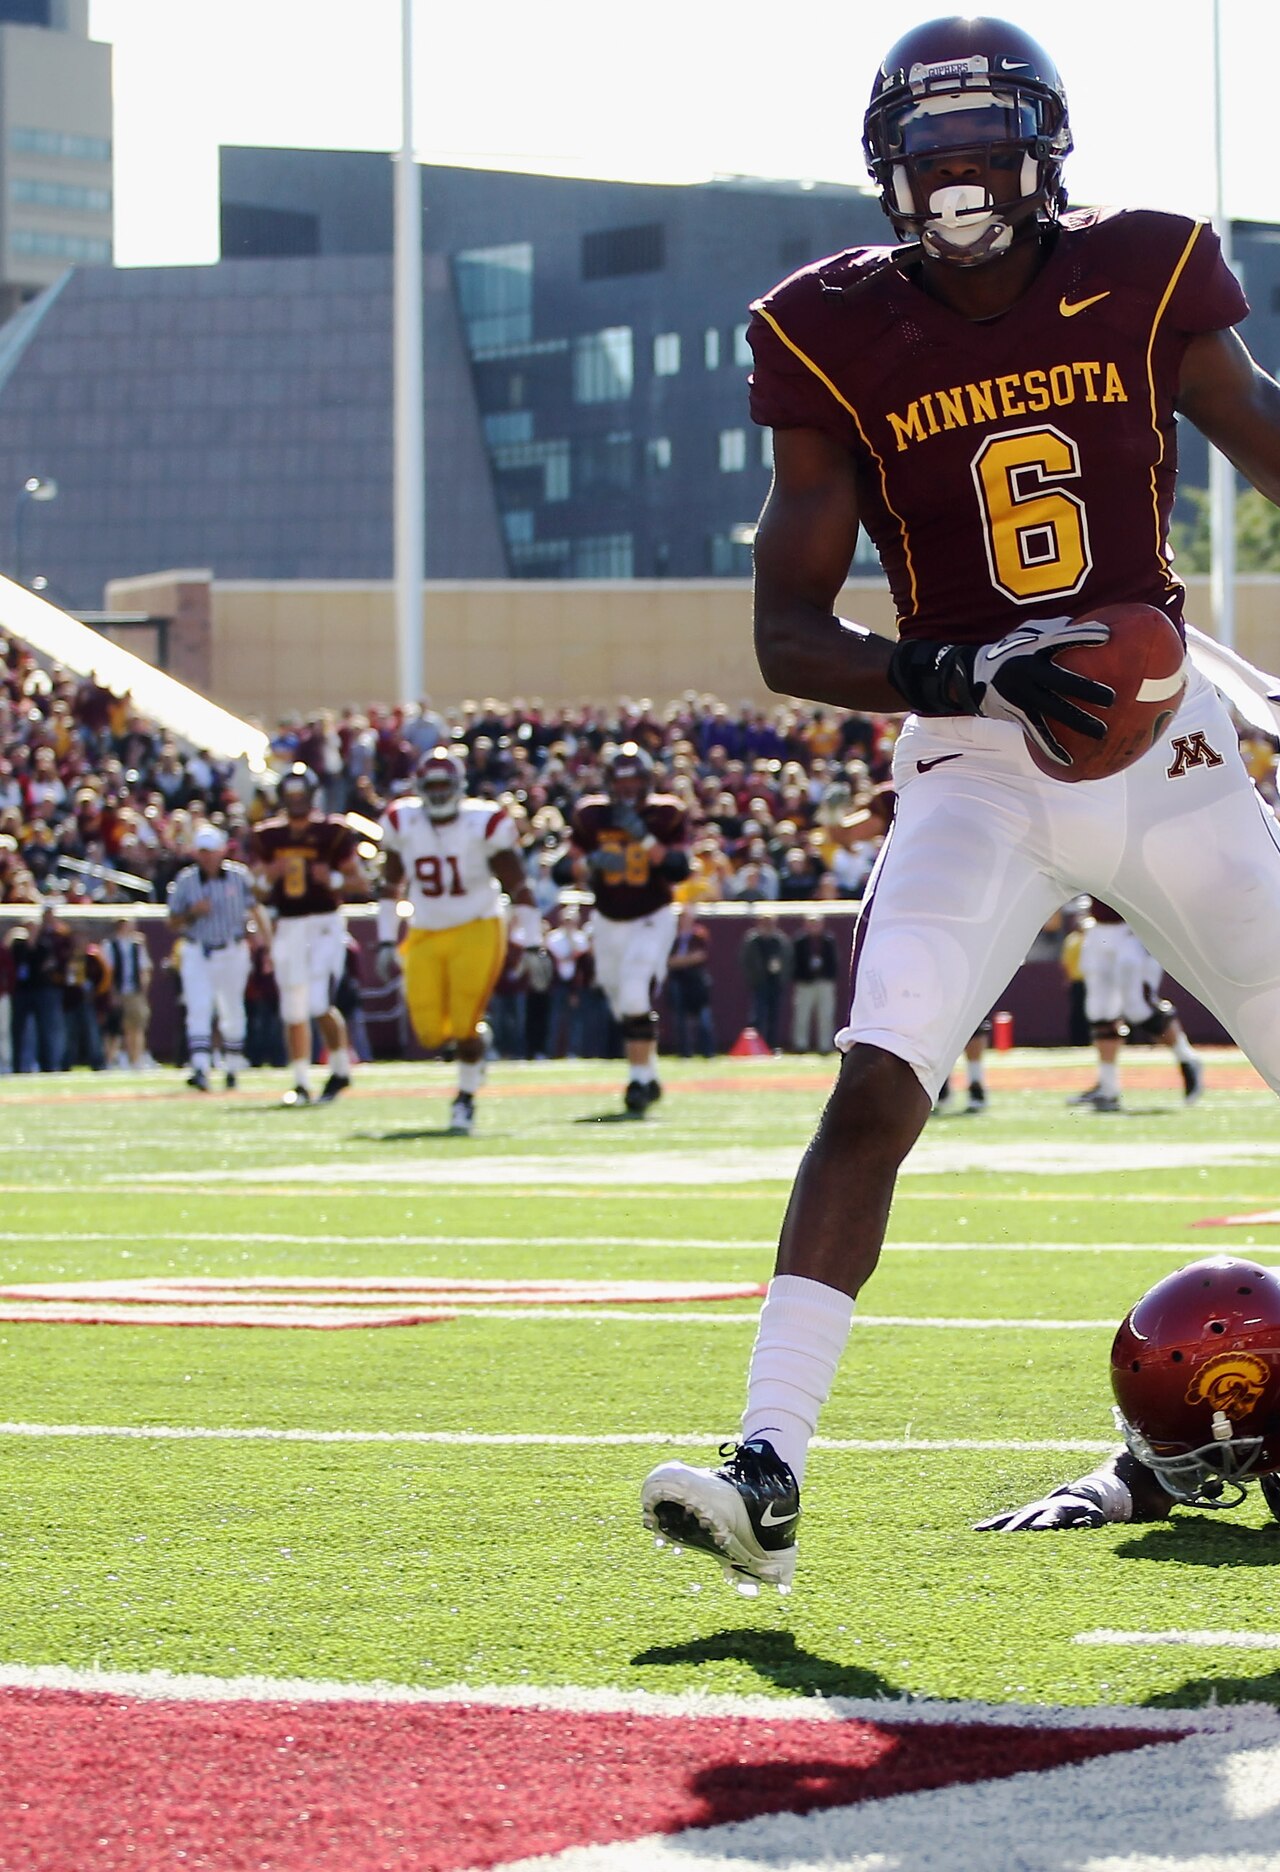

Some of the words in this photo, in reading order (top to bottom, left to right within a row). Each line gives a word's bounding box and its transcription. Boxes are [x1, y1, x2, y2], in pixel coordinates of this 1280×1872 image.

[886, 362, 1128, 452] MINNESOTA
[970, 423, 1093, 605] 6
[1166, 729, 1225, 781] M
[414, 855, 467, 897] 91
